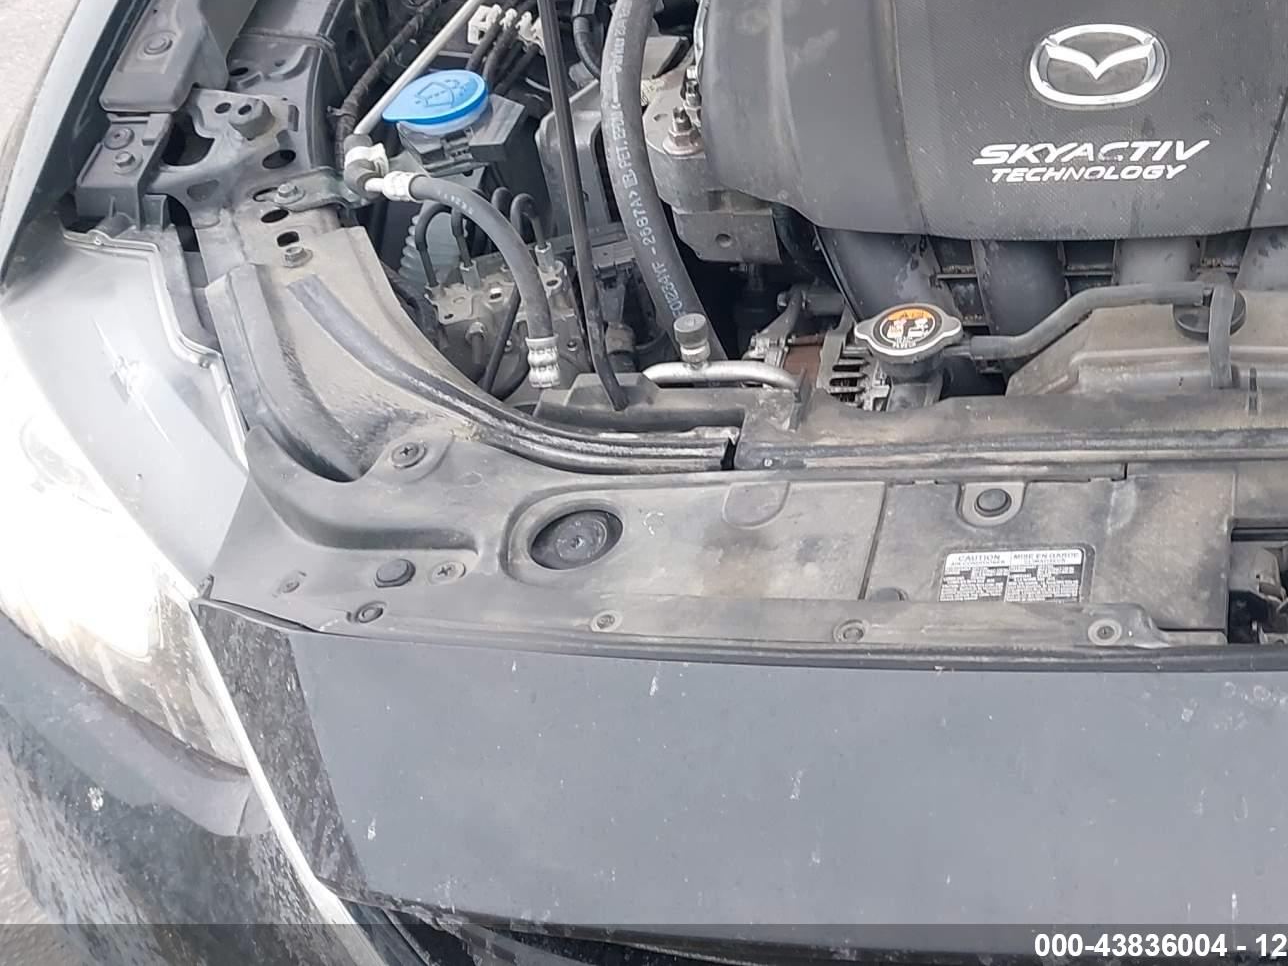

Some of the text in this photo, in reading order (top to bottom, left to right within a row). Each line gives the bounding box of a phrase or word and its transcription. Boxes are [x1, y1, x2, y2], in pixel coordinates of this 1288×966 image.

[972, 139, 1211, 166] SKYACTIV
[990, 164, 1188, 184] TECHNOLOGY
[958, 554, 1001, 562] CAUTION
